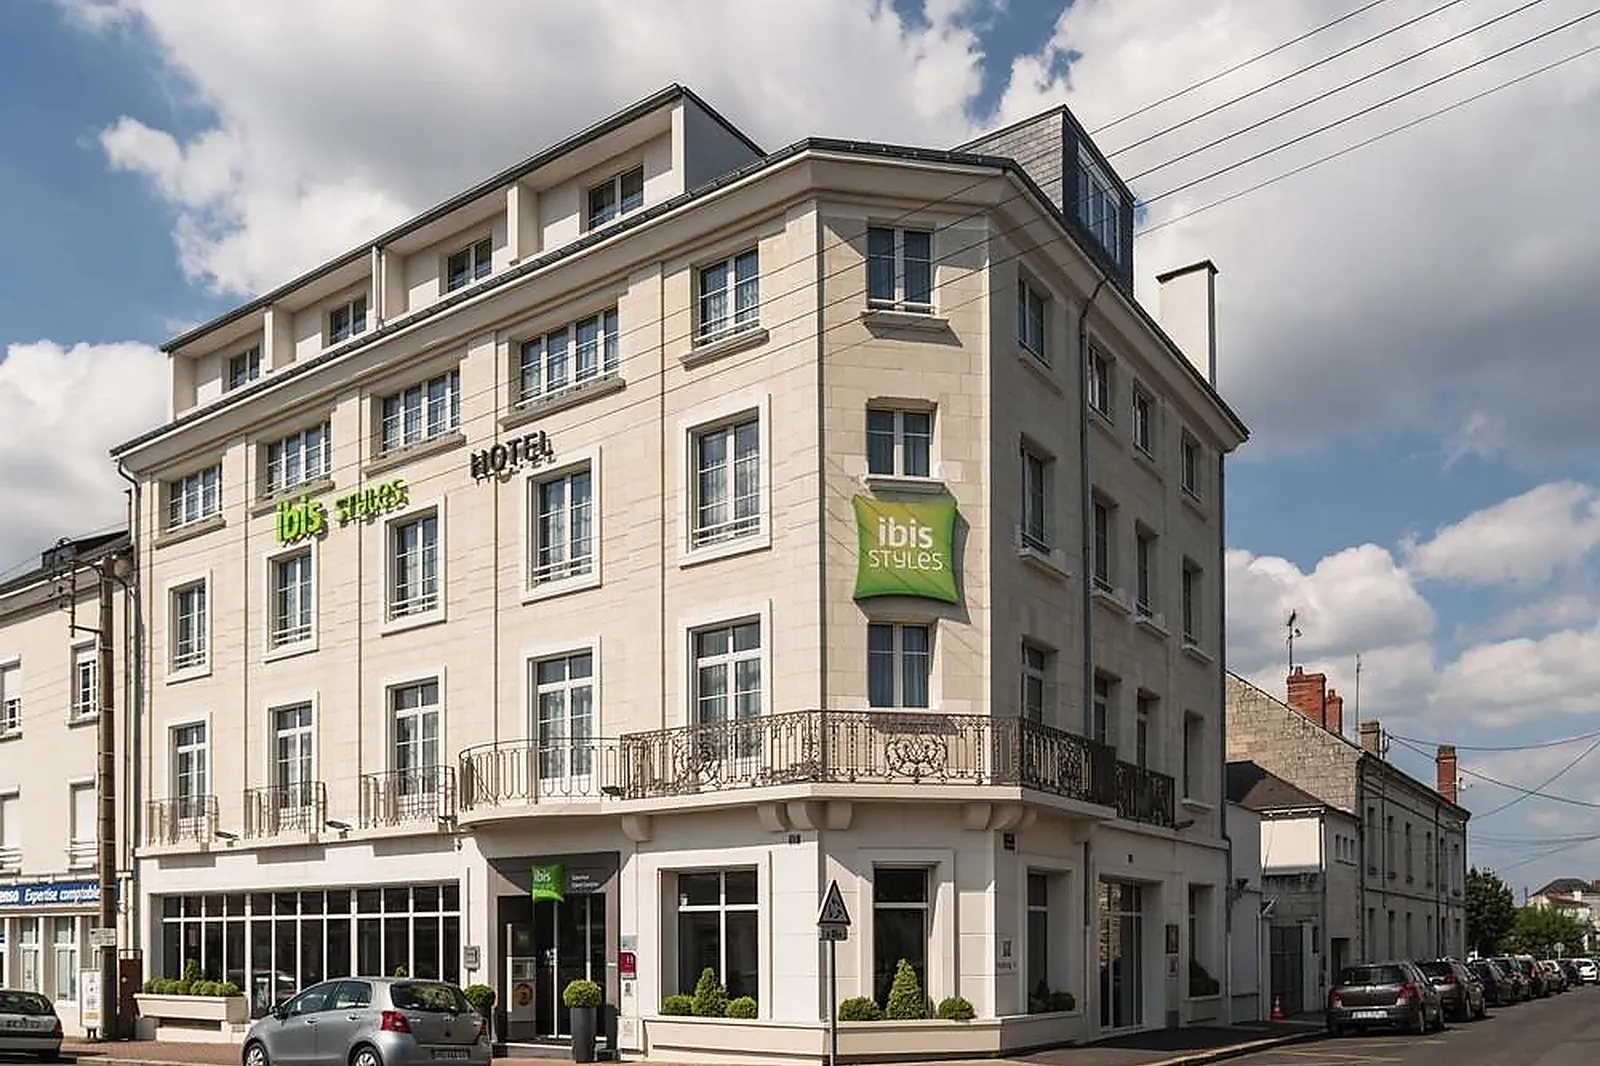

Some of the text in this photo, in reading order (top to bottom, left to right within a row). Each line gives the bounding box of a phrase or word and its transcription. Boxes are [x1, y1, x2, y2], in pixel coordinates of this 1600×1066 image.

[471, 430, 553, 479] HOTEL
[276, 495, 323, 544] ibis
[877, 516, 934, 549] ibis
[25, 888, 58, 905] Expertise
